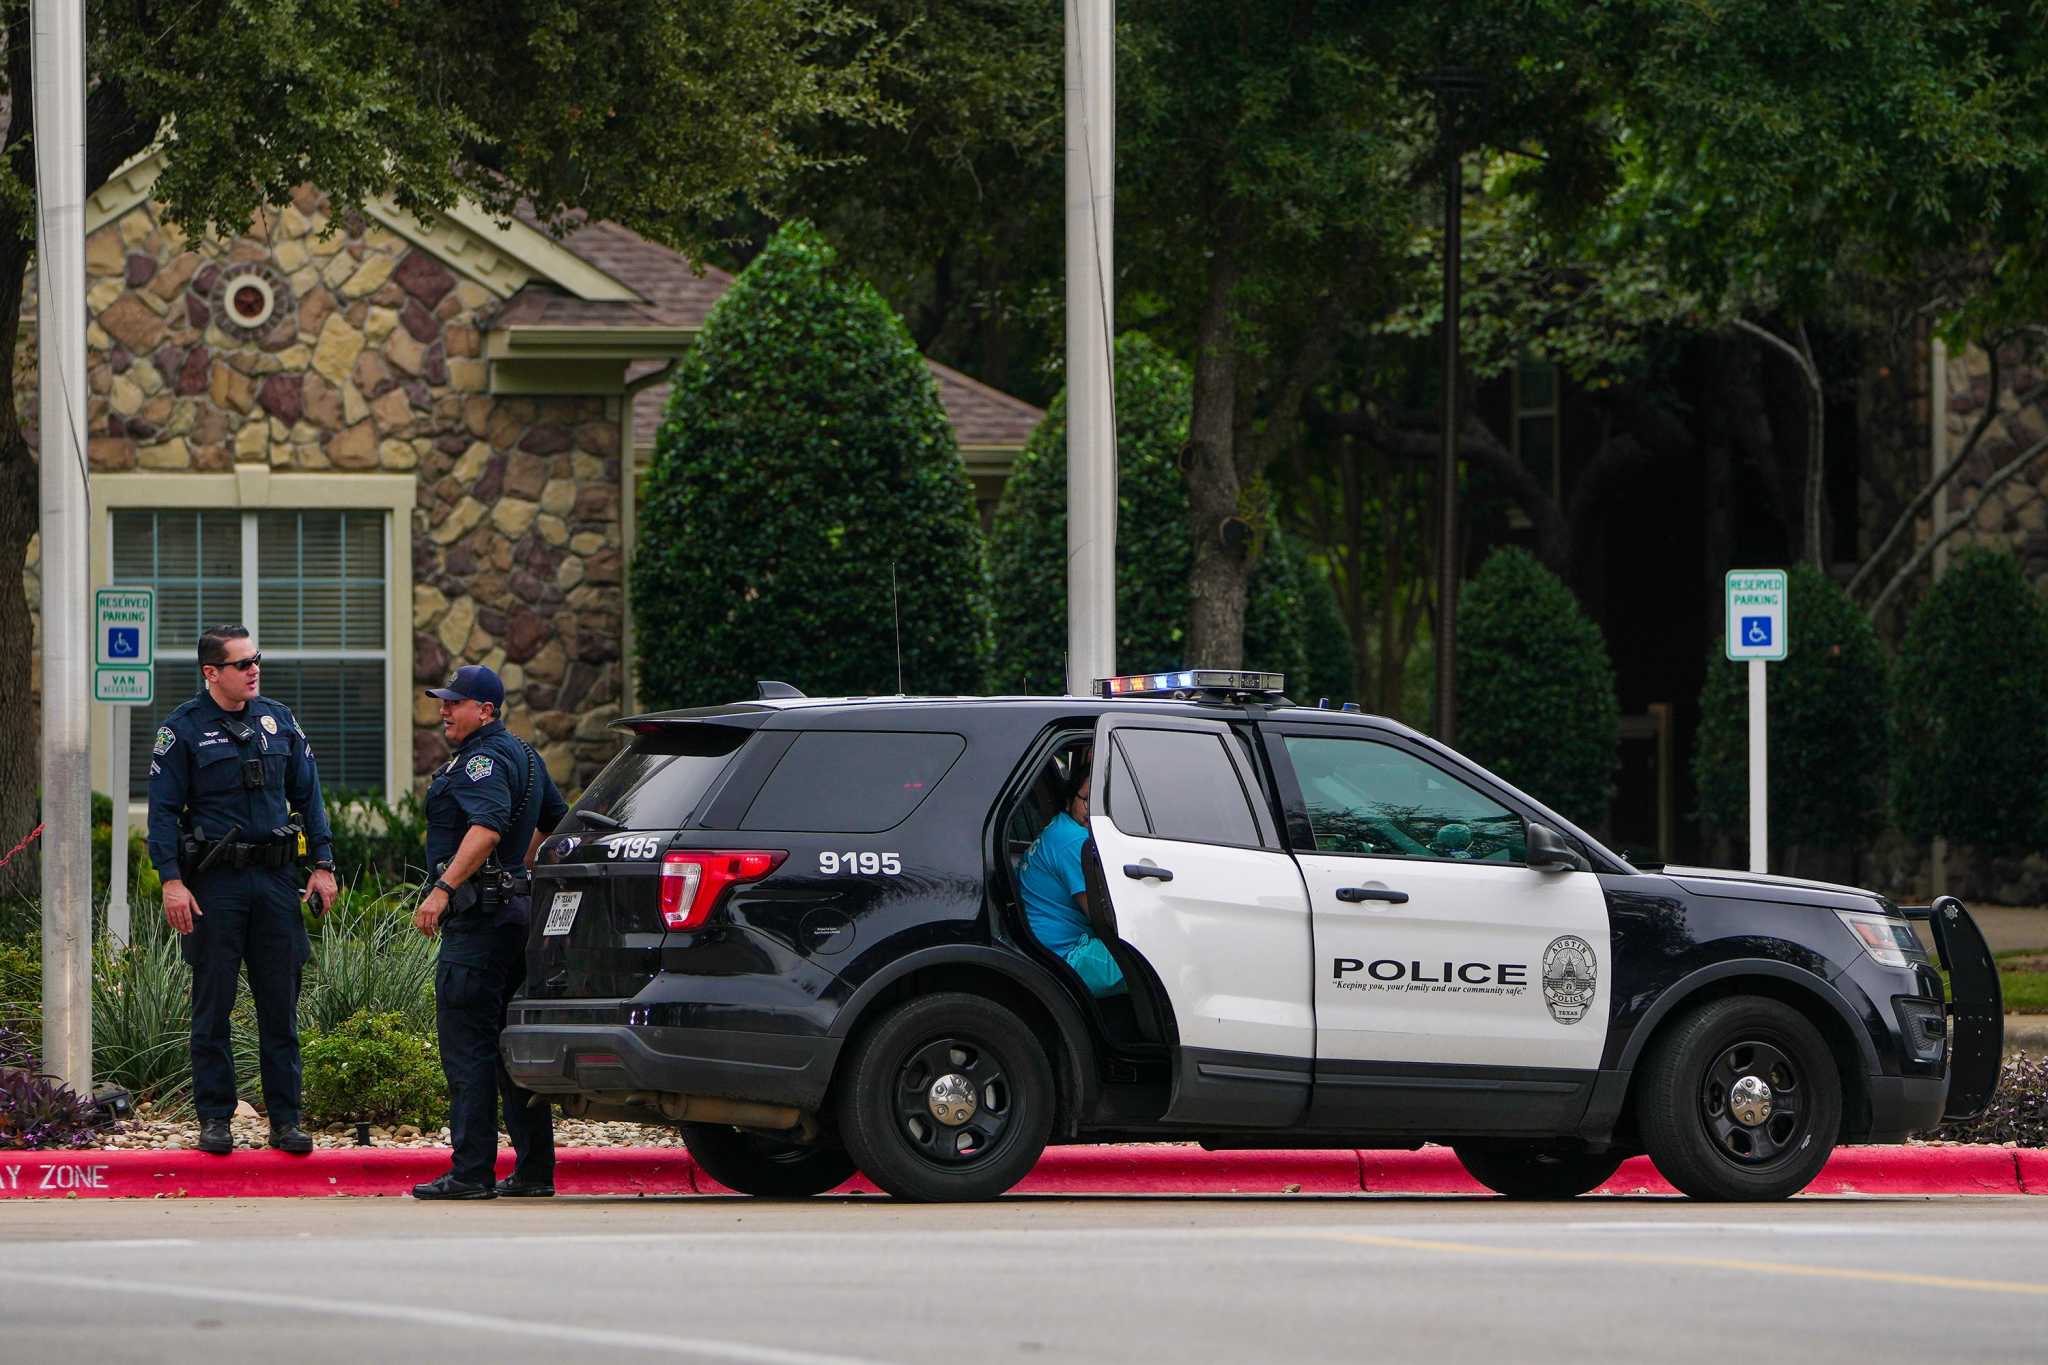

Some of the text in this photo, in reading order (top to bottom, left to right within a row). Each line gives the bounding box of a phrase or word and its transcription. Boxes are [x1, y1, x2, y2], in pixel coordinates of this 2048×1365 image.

[1730, 580, 1781, 590] RESERVED
[100, 598, 149, 608] RESERVED
[1734, 594, 1778, 605] PARKING
[103, 611, 145, 621] PARKING
[112, 675, 136, 685] VAN
[607, 837, 660, 859] 9195
[819, 851, 902, 875] 9195
[1551, 940, 1587, 954] AUSTIN
[1333, 957, 1528, 986] POLICE
[1387, 983, 1404, 992] your
[1404, 983, 1429, 993] family
[1431, 984, 1447, 992] and
[1462, 986, 1505, 996] community
[1552, 992, 1585, 1003] POLICE
[39, 1165, 109, 1189] ZONE
